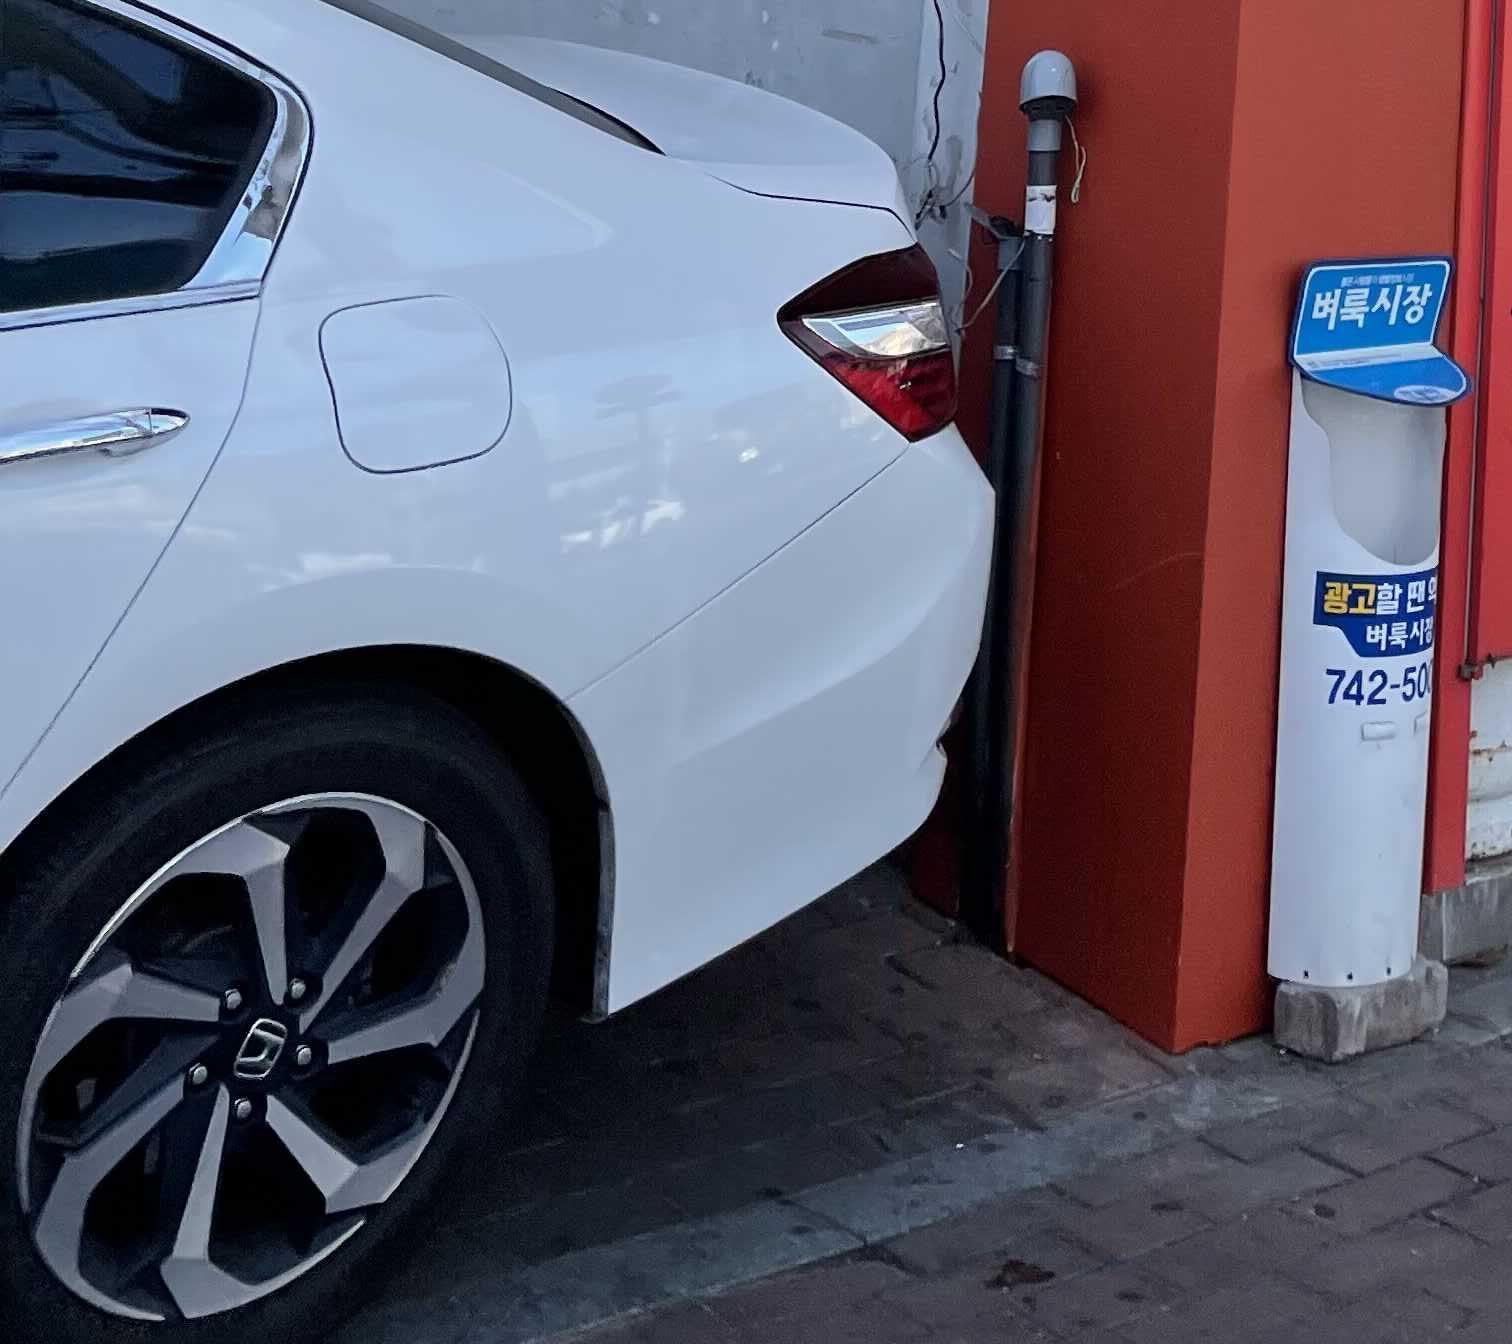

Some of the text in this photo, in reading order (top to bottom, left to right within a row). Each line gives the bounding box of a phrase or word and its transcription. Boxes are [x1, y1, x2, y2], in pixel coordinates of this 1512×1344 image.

[1311, 282, 1433, 332] 벼룩시장
[1323, 581, 1403, 616] 광고할
[1366, 615, 1434, 651] 벼룩시장
